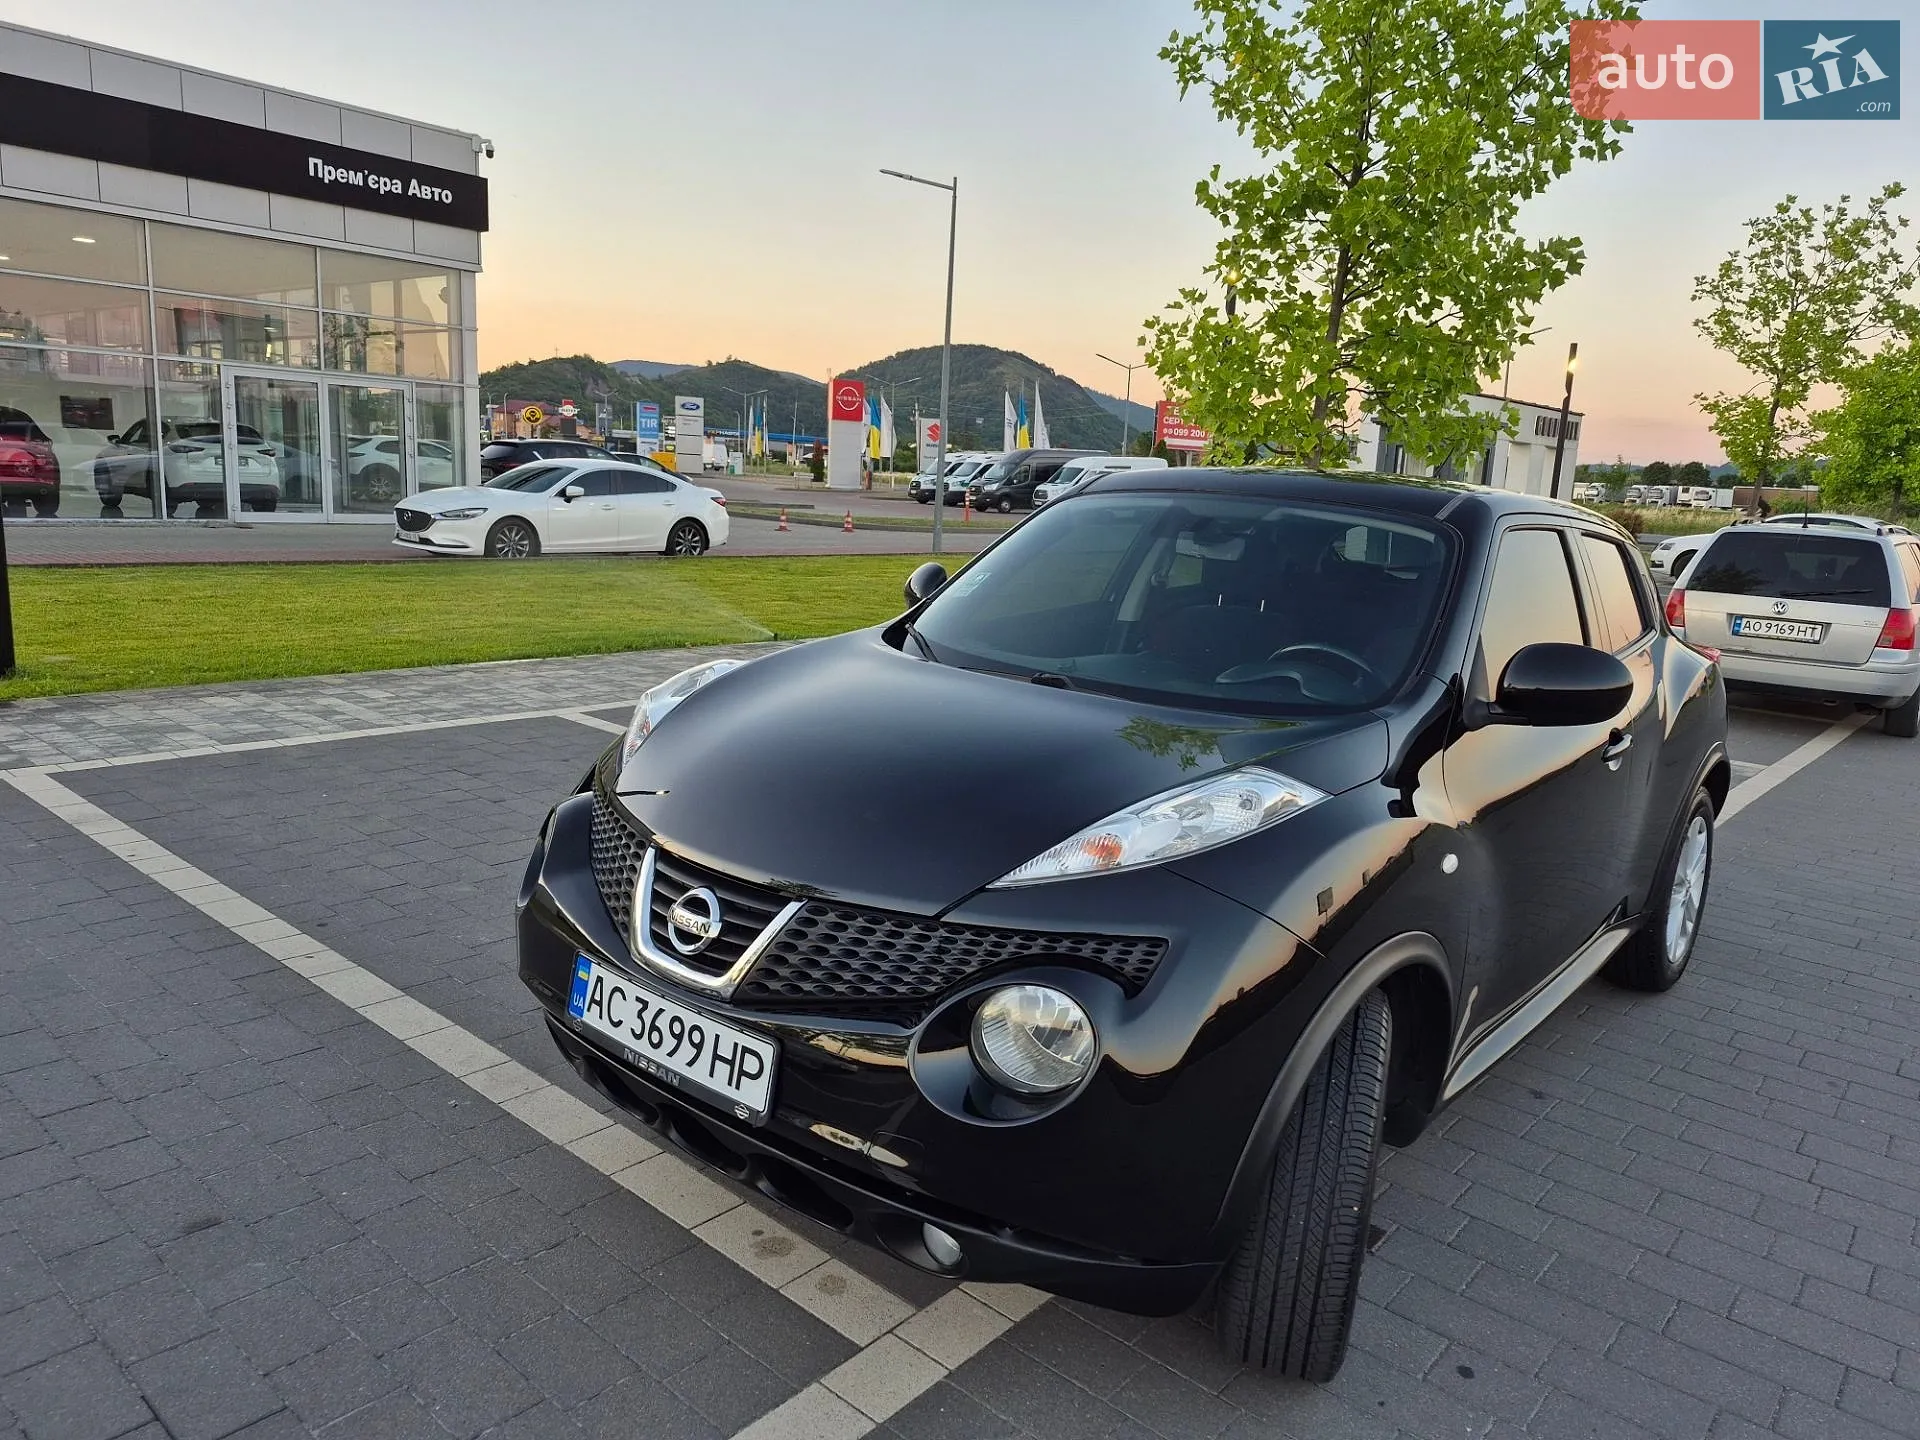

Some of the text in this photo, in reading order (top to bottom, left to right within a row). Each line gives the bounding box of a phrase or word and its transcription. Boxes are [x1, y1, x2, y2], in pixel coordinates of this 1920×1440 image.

[407, 178, 453, 204] Авто
[640, 418, 657, 428] TIR
[1743, 620, 1762, 632] AO
[1765, 622, 1795, 635] 9169
[1796, 626, 1818, 637] HT
[669, 907, 711, 934] NISSAN
[573, 993, 585, 1009] UA
[586, 974, 765, 1091] AC 3699 HP
[623, 1047, 681, 1088] NISSAN
